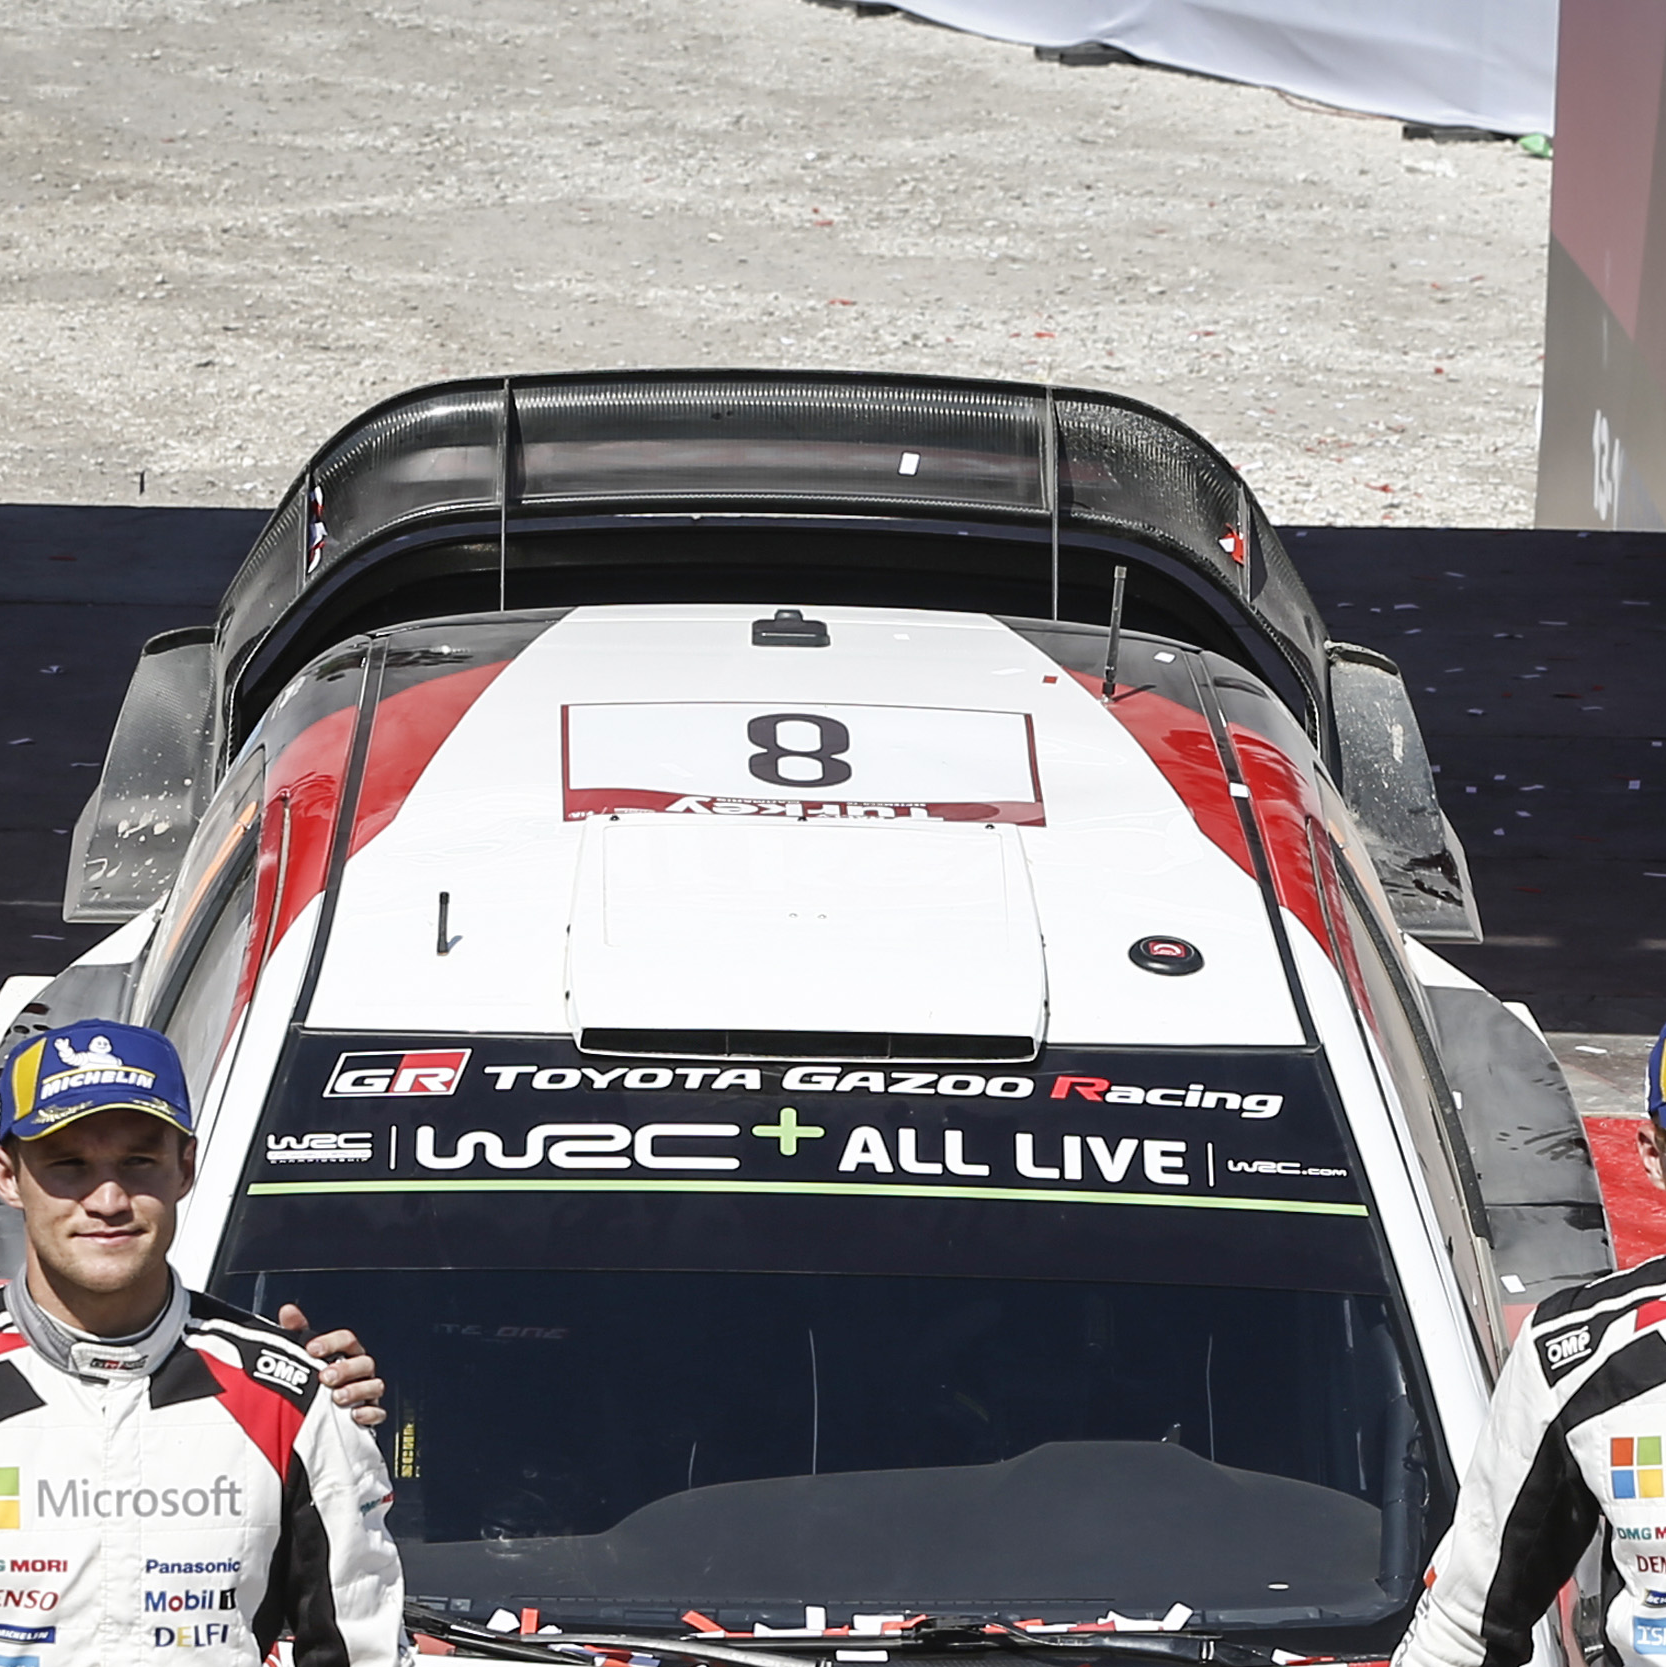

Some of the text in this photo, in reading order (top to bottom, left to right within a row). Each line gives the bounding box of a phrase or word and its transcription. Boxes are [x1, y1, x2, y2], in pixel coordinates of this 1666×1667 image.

[747, 712, 852, 788] 8
[40, 1070, 156, 1100] MICHELIN
[332, 1065, 1285, 1120] GR TOYOTA GAZOO Racing
[838, 1125, 1190, 1186] ALL LIVE
[1546, 1331, 1591, 1364] OMP
[255, 1355, 309, 1387] OMP
[36, 1475, 243, 1520] Microsoft
[10, 1558, 68, 1574] MORI
[145, 1558, 241, 1574] Panasonic
[144, 1590, 215, 1613] Mobil
[154, 1623, 229, 1647] DELFI
